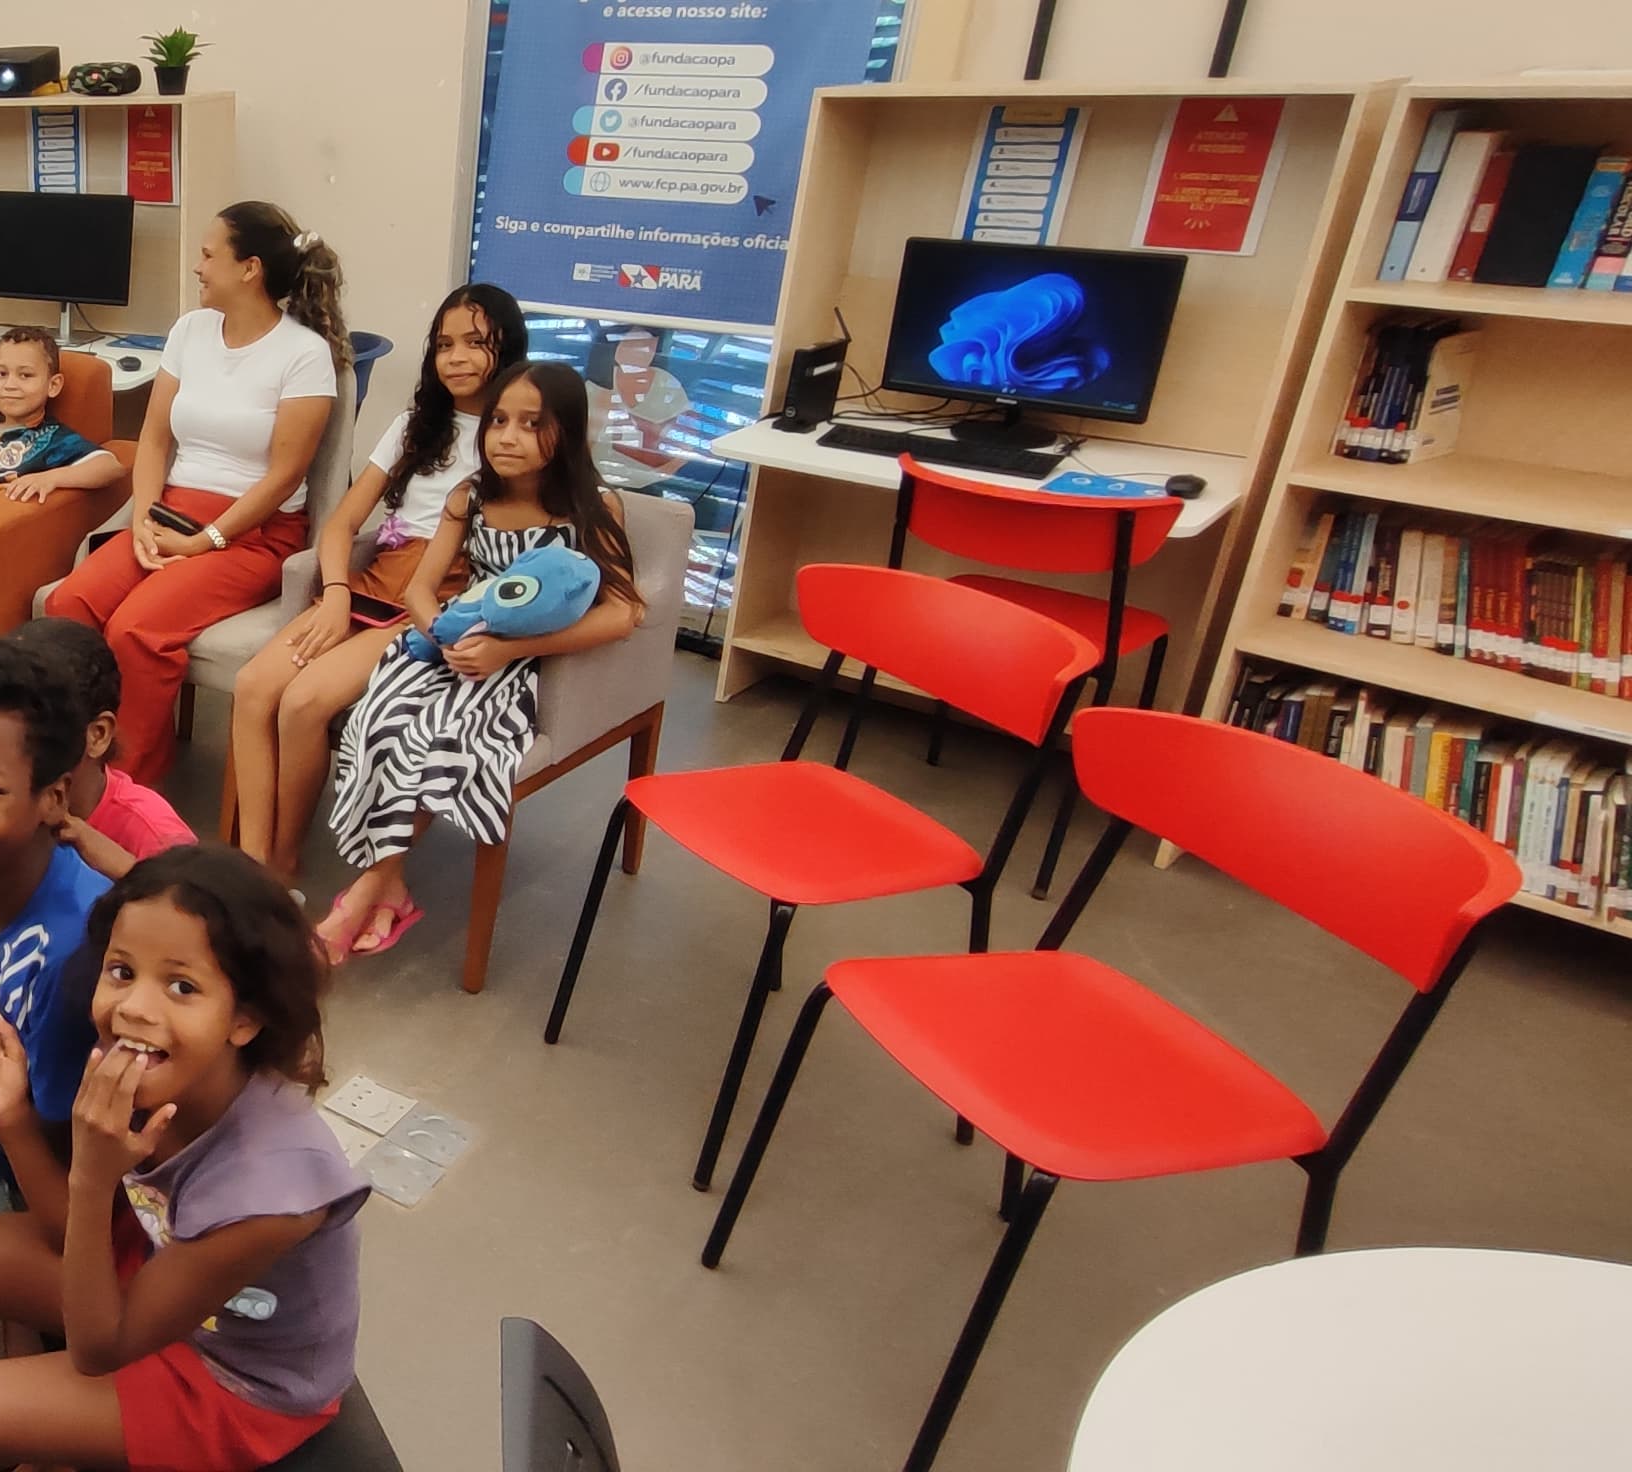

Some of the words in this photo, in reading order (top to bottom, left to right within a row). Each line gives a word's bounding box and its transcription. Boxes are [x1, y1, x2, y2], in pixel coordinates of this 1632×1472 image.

[603, 5, 614, 18] e
[617, 5, 672, 18] acesse
[676, 5, 726, 19] nosso
[729, 2, 768, 19] site:
[638, 49, 736, 67] @fundacaopa
[632, 82, 742, 101] /fundacaopara
[628, 115, 737, 133] @fundacaopara
[623, 146, 729, 164] /fundacaopara
[618, 178, 743, 197] www.fcp.pa.gov.br
[494, 215, 528, 233] Siga
[529, 220, 540, 232] e
[543, 221, 635, 240] compartilhe
[637, 227, 740, 249] informações
